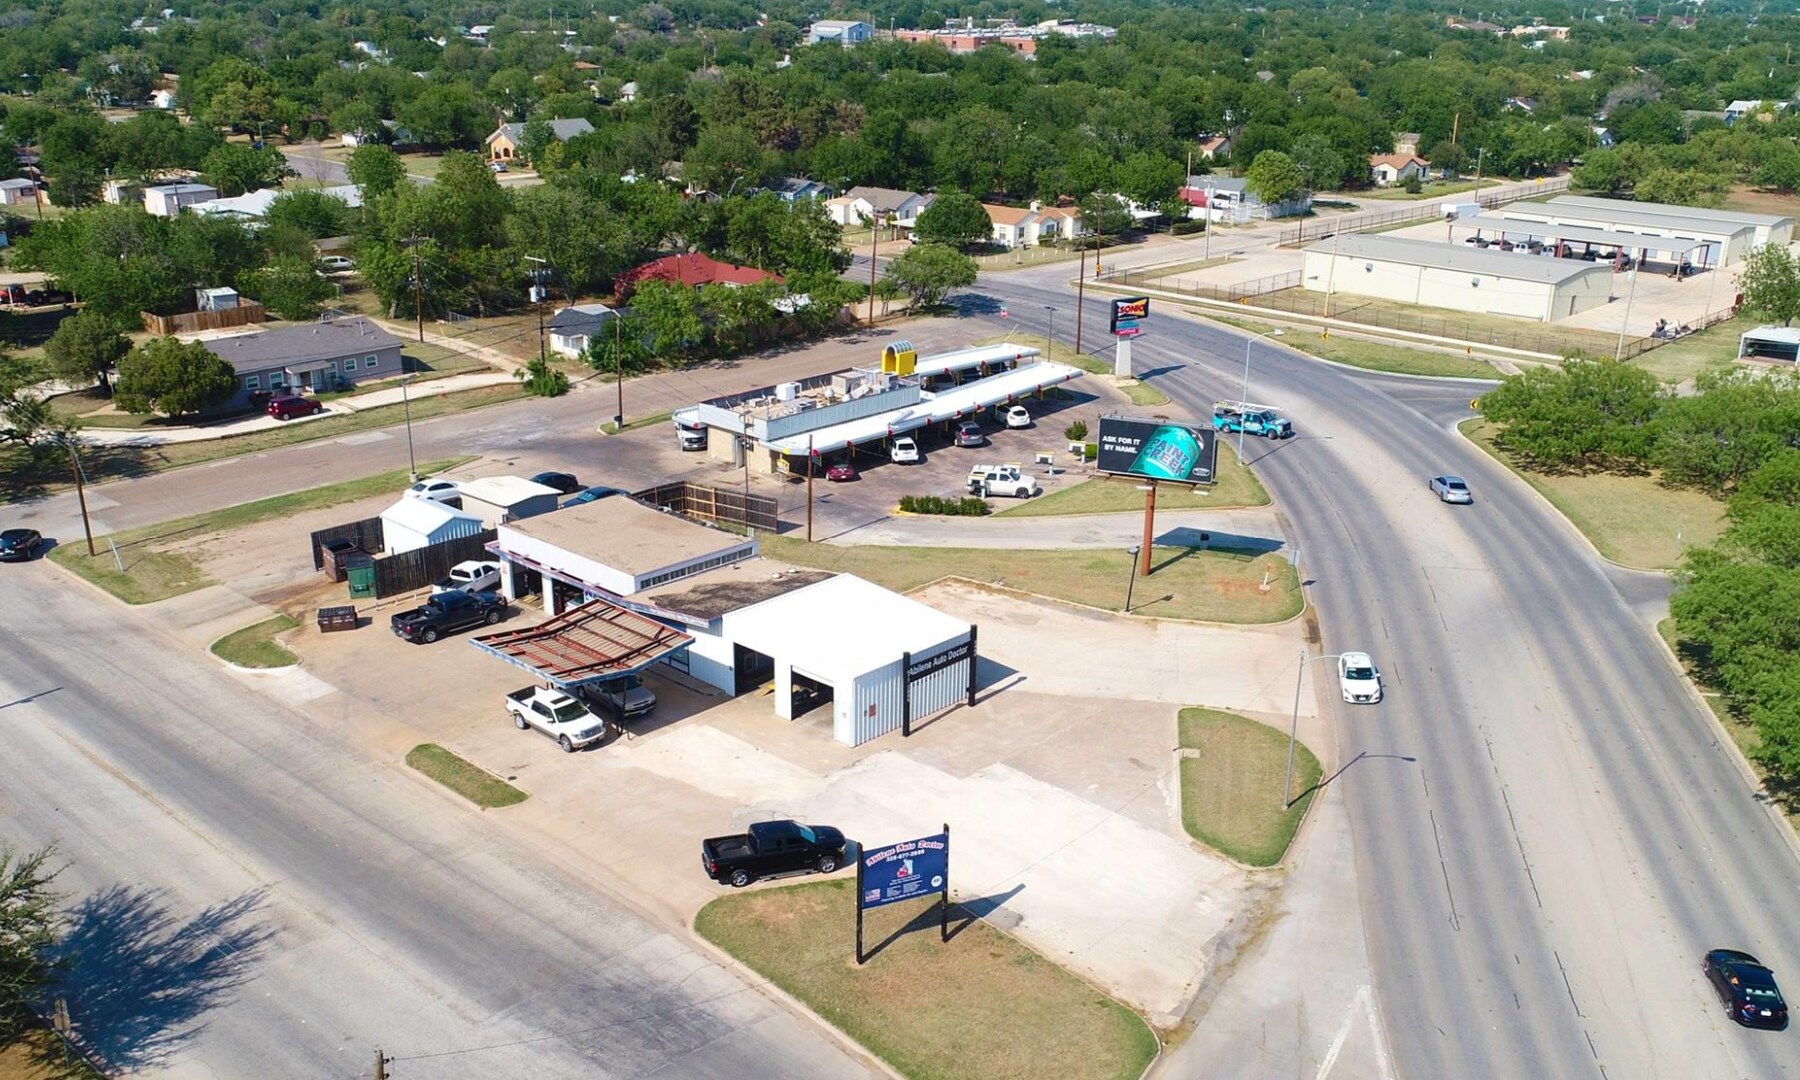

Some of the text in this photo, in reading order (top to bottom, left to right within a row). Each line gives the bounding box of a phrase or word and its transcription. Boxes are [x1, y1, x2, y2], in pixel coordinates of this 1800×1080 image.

[1120, 304, 1144, 313] SONIC
[1102, 435, 1141, 446] ASK FOR IT
[1115, 445, 1137, 454] NAME.
[1152, 438, 1190, 466] PAINT
[1143, 447, 1185, 477] CREEK
[908, 661, 931, 675] Abilene
[933, 656, 947, 667] Auto
[948, 646, 968, 660] Doctor
[896, 843, 916, 853] Auto
[918, 840, 944, 850] Doctor
